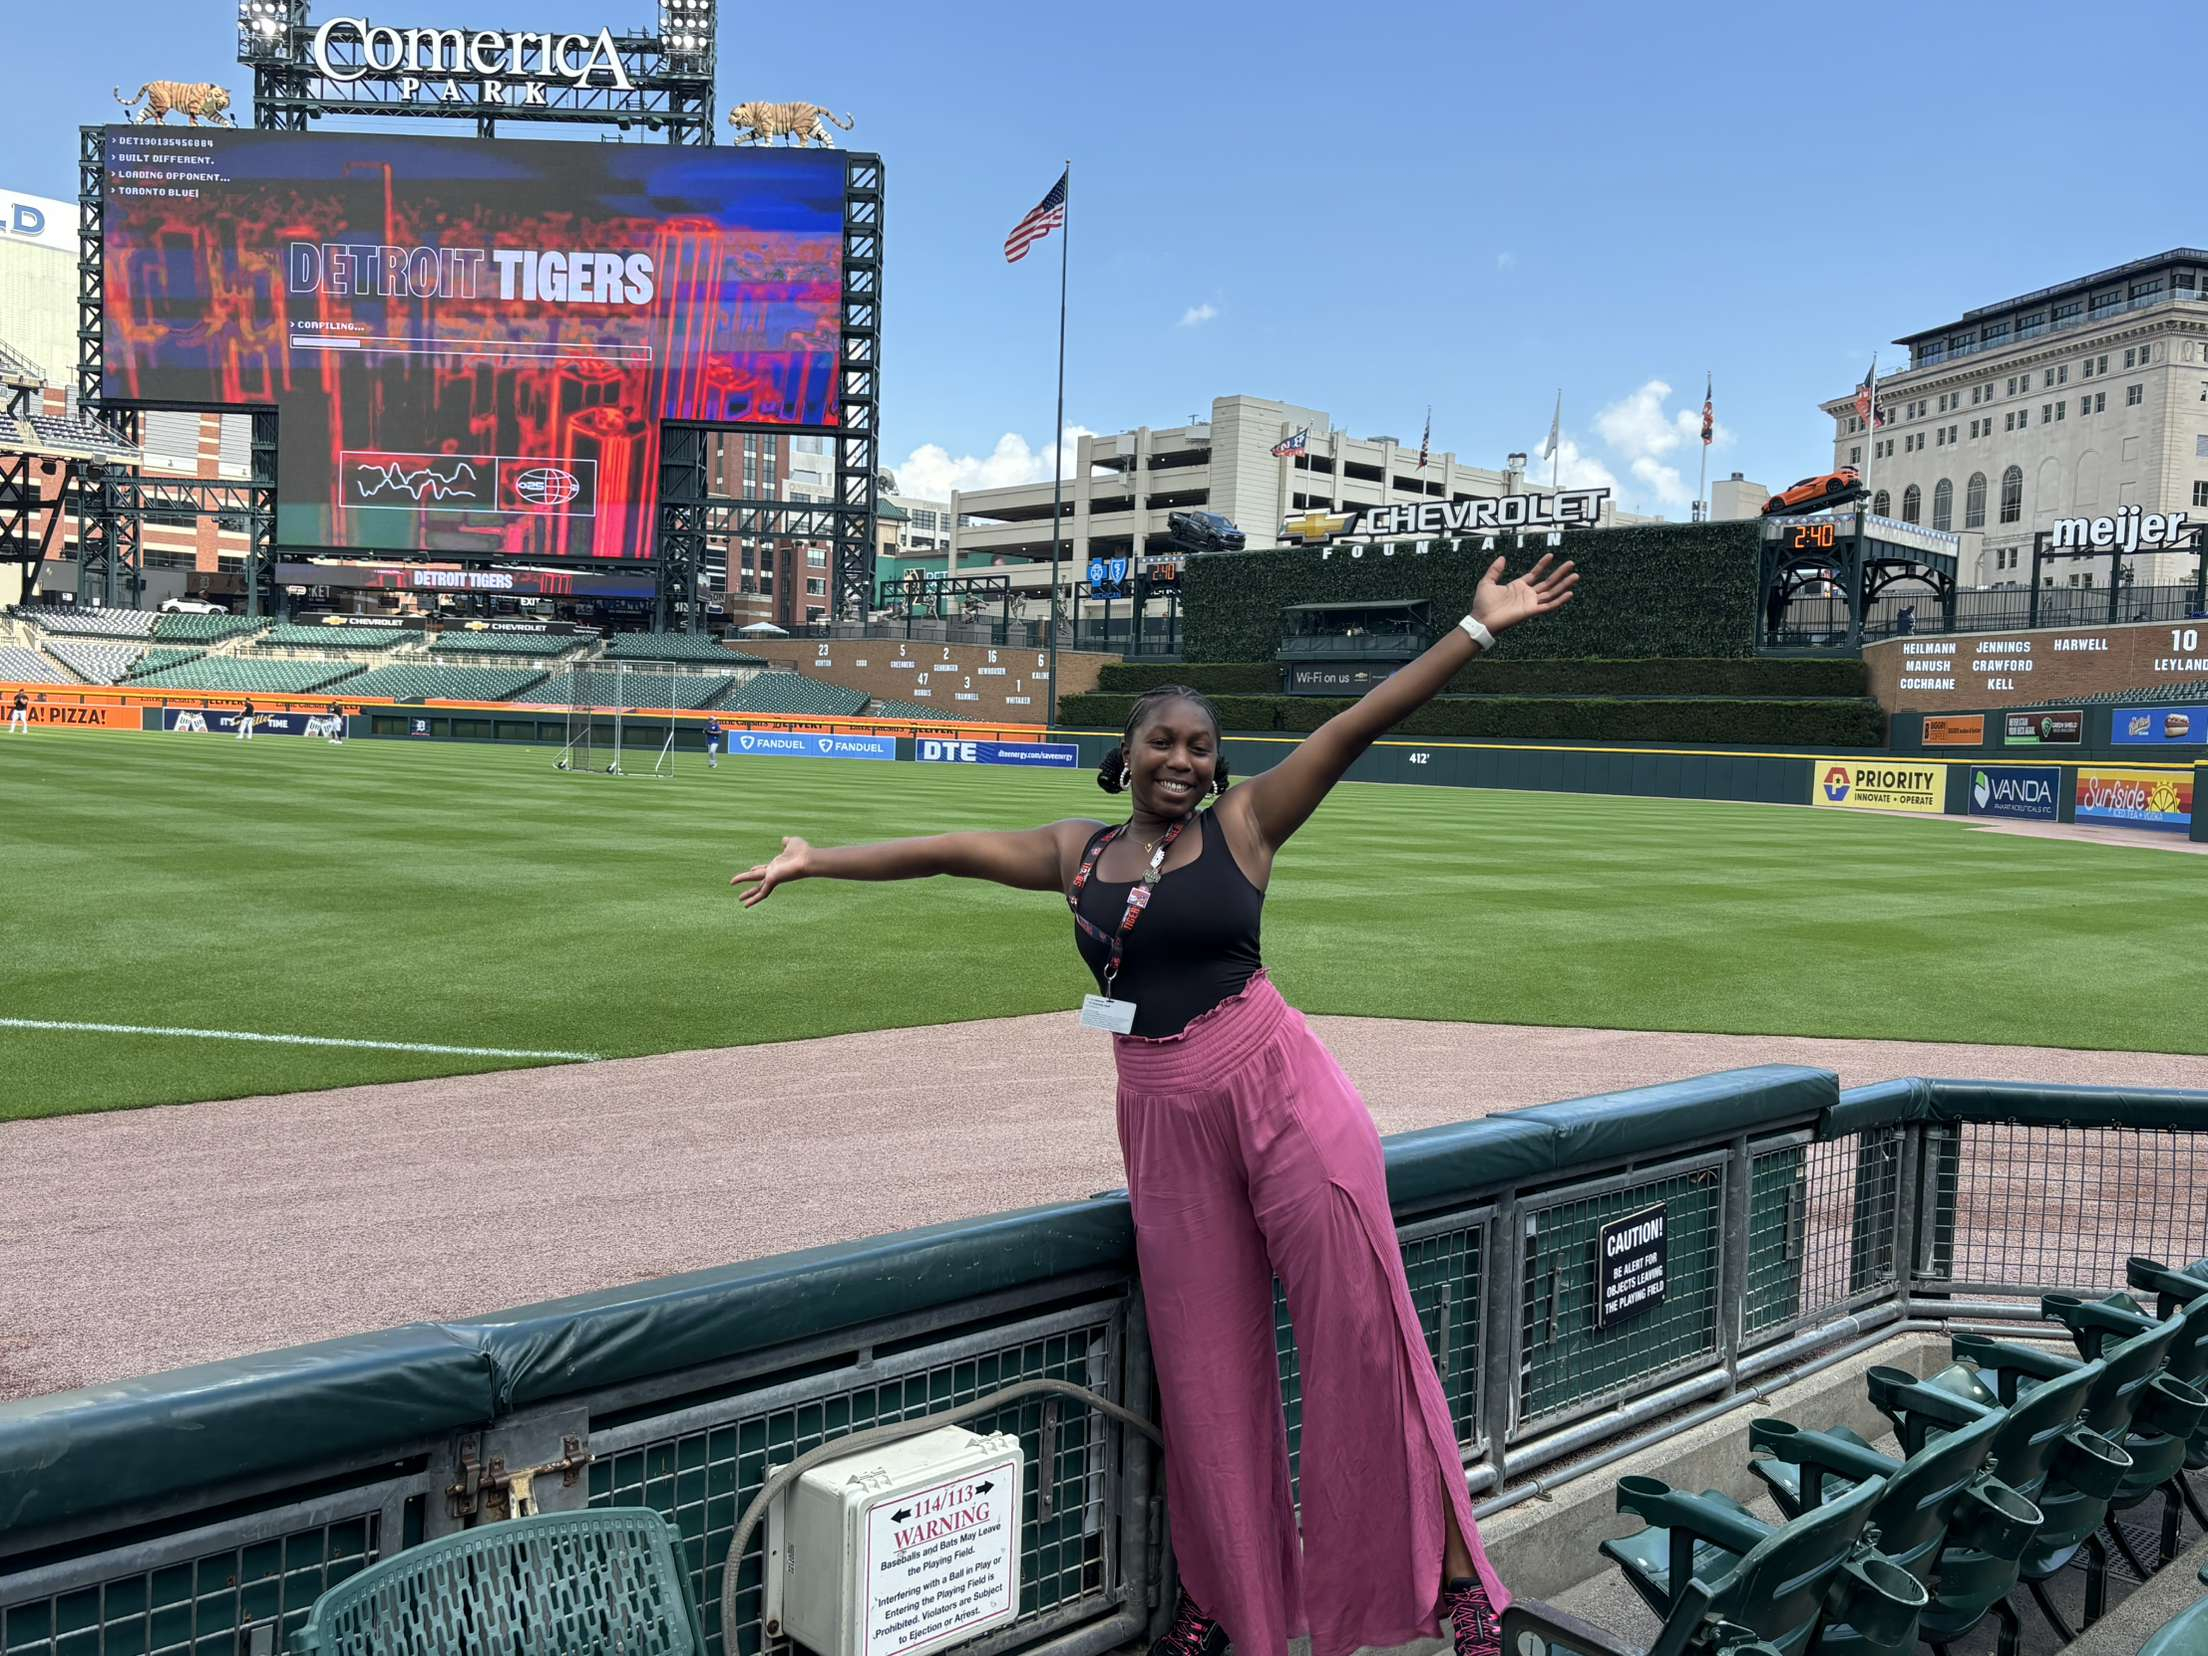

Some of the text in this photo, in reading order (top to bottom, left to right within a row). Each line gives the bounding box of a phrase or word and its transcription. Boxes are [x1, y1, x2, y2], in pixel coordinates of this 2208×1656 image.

[402, 77, 548, 105] PARK
[119, 154, 215, 165] BUILT DIFFERENT.
[119, 170, 163, 179] LOADING
[119, 187, 166, 196] TORONTO
[290, 242, 654, 305] DETROIT TIGERS
[1365, 488, 1609, 536] CHEVROLET
[1795, 524, 1833, 548] 2:40
[2052, 505, 2186, 553] meijer
[1322, 531, 1562, 560] FOUNTAIN
[414, 571, 513, 589] DETROIT TIGERS
[349, 618, 403, 627] CHEVROLET
[492, 623, 547, 632] CHEVROLET
[1976, 641, 2031, 653] JENNINGS
[2054, 639, 2109, 651] HARWELL
[2171, 630, 2198, 651] 10
[818, 644, 829, 656] 23
[900, 644, 906, 657] 5
[943, 648, 950, 660] 2
[1903, 643, 1956, 655] HEILMANN
[988, 650, 997, 663] 16
[1038, 654, 1044, 667] 6
[1906, 660, 1951, 672] MANUSH
[1972, 660, 2033, 672] CRAWFORD
[917, 673, 929, 685] 47
[964, 676, 970, 689] 3
[1296, 672, 1350, 683] Wi-Fi on us
[1900, 678, 1956, 690] COCHRANE
[1987, 678, 2014, 690] KELL
[50, 709, 107, 725] PIZZA!
[268, 719, 289, 728] TIME
[757, 738, 805, 749] FANDUEL
[835, 741, 884, 752] FANDUEL
[924, 742, 976, 762] DTE
[1409, 753, 1430, 764] 412'
[1856, 769, 1934, 790] PRIORITY
[1991, 779, 2052, 803] VANDA
[2084, 776, 2145, 811] Surfside
[1855, 793, 1933, 805] INNOVATE OPERATE
[1607, 1217, 1663, 1257] CAUTION!
[1613, 1252, 1658, 1280] BE ALERT FOR
[1607, 1265, 1663, 1298] OBJECTS LEAVING
[1605, 1280, 1664, 1314] THE PLAYING FIELD
[915, 1485, 974, 1519] 114/113
[894, 1502, 990, 1550] WARNING
[880, 1523, 1001, 1571] Baseballs and Bats May Leave
[908, 1546, 975, 1577] the Playing Field.
[878, 1556, 1001, 1607] Interfering with a Ball in Play or
[885, 1572, 994, 1620] Entering the Playing Field is
[875, 1583, 1003, 1639] Prohibited. Violators are Subject
[898, 1606, 980, 1645] to Ejection or Arrest.
